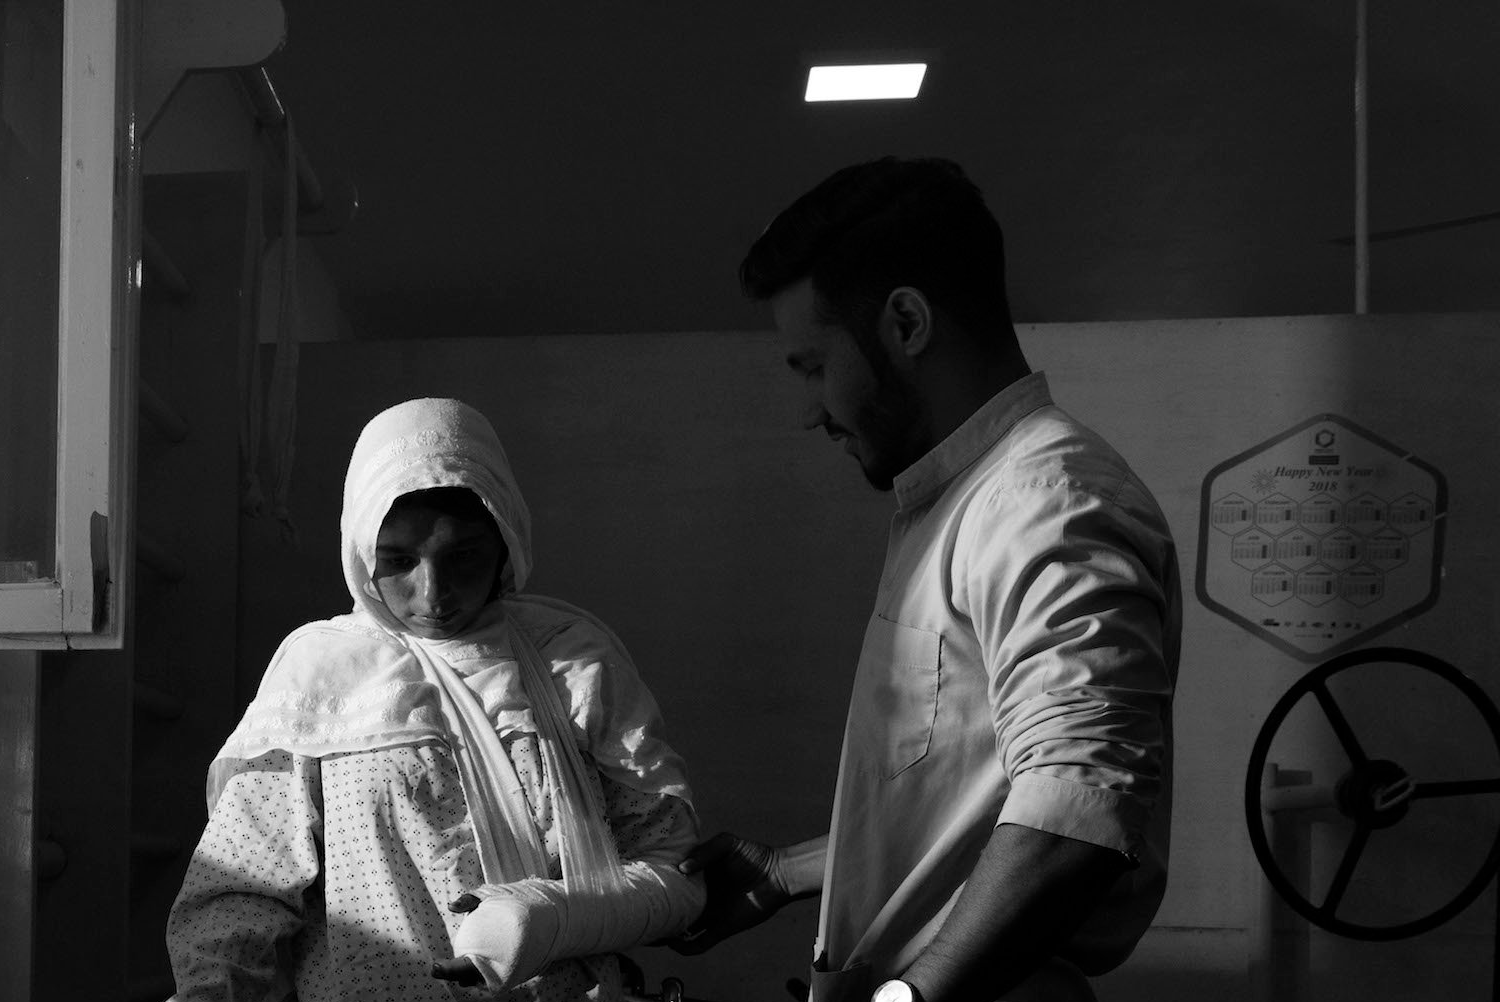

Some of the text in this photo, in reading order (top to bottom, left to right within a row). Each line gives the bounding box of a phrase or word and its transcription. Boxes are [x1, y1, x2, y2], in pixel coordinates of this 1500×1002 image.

[1274, 465, 1374, 479] Happy New Year
[1308, 481, 1339, 492] 2018
